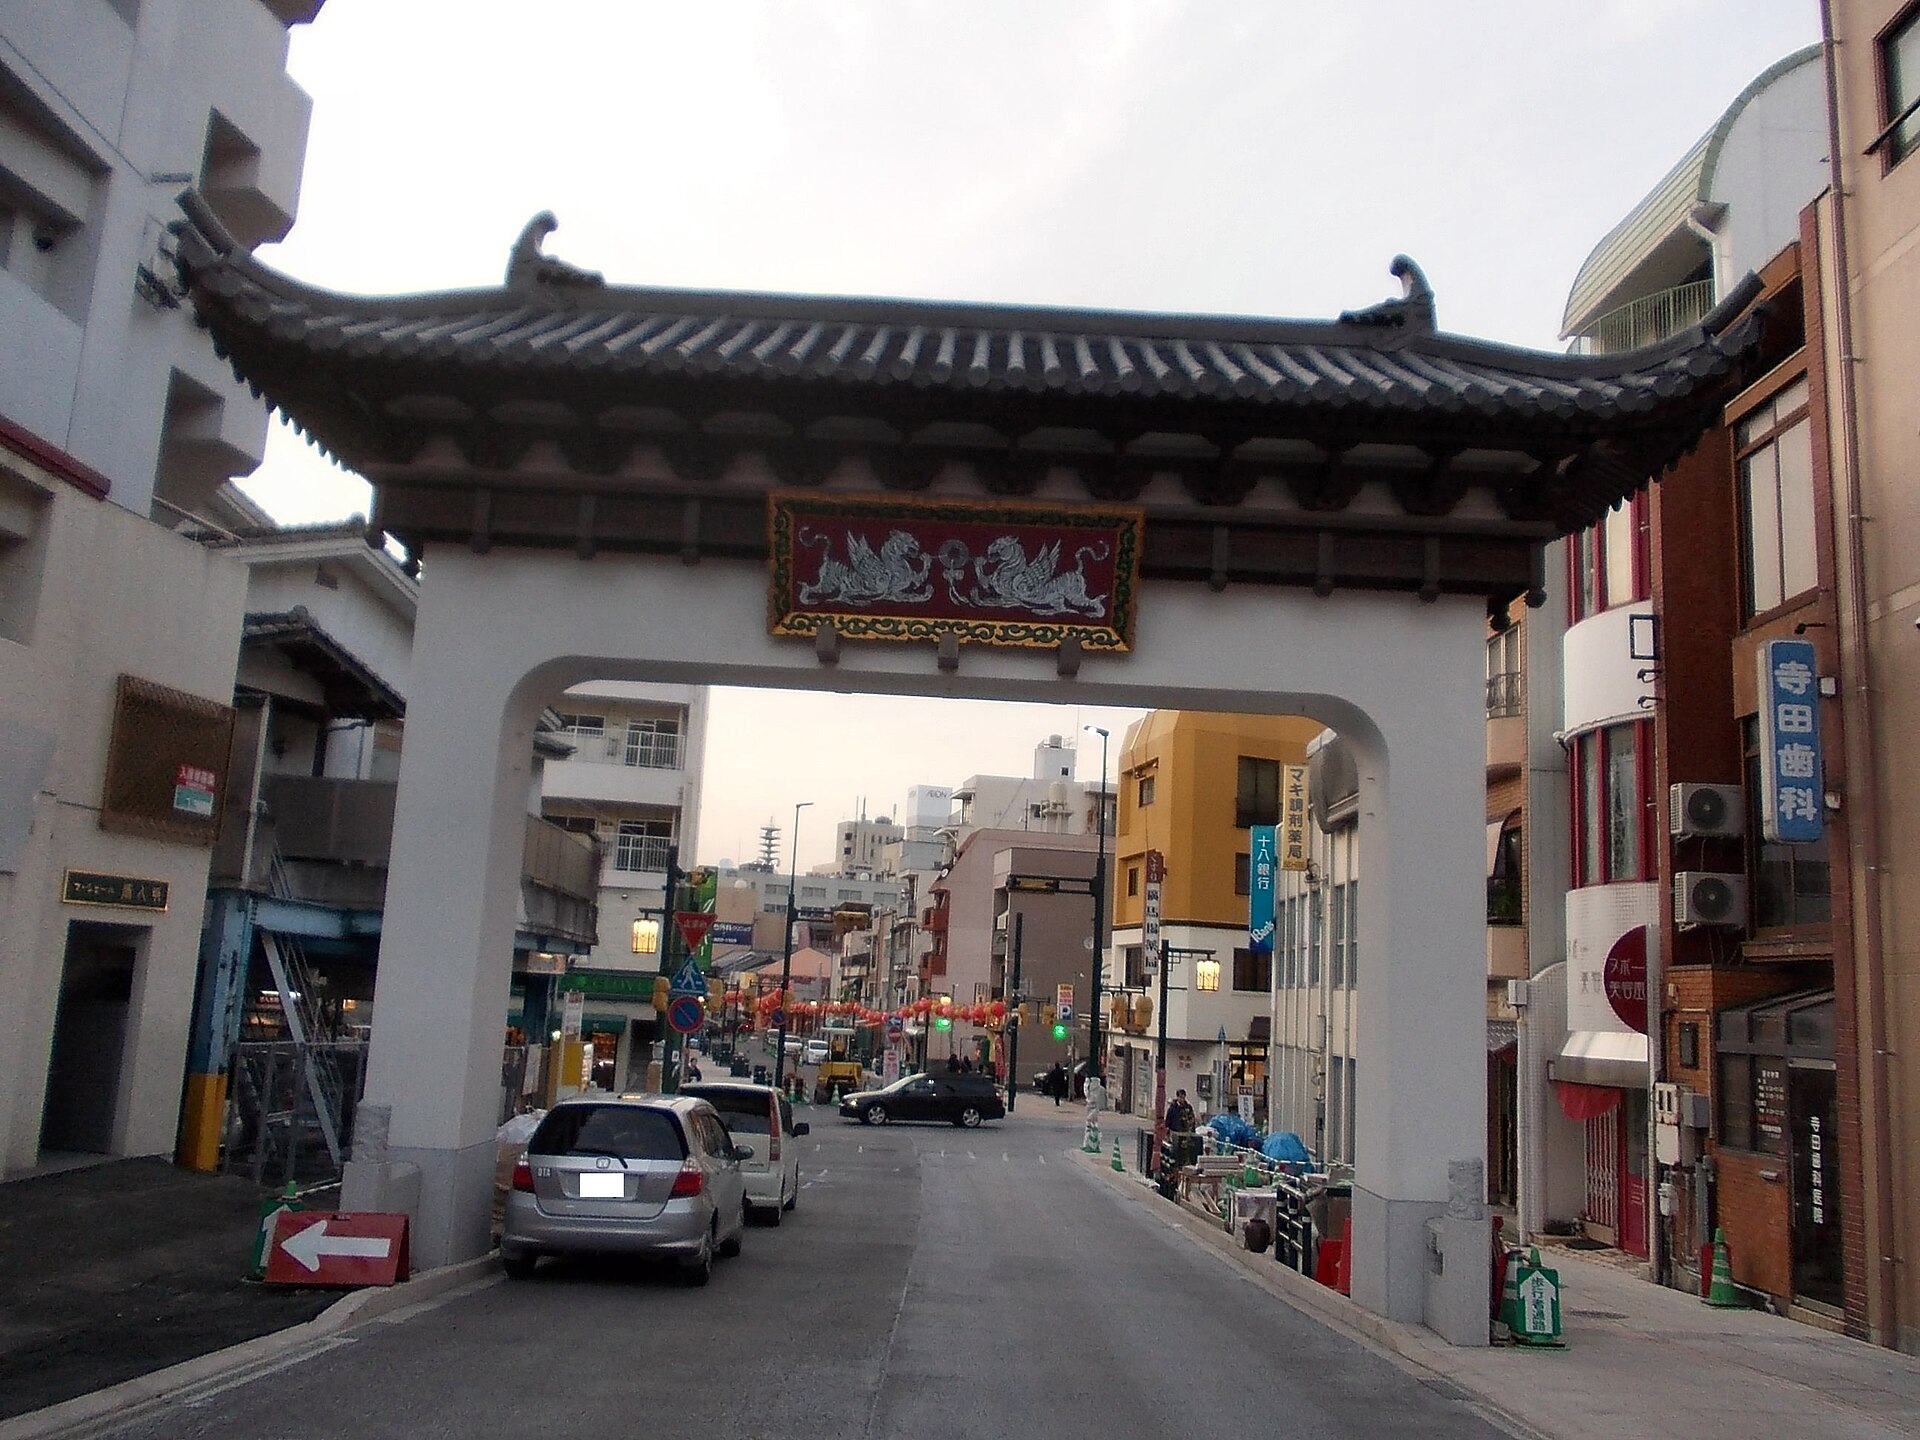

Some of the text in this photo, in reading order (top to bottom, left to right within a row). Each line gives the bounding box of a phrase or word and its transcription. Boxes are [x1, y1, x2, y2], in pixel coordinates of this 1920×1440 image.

[1774, 660, 1818, 821] 寺田歯科
[1288, 768, 1304, 859] マキ調剤薬局
[1257, 835, 1271, 890] 十八銀行
